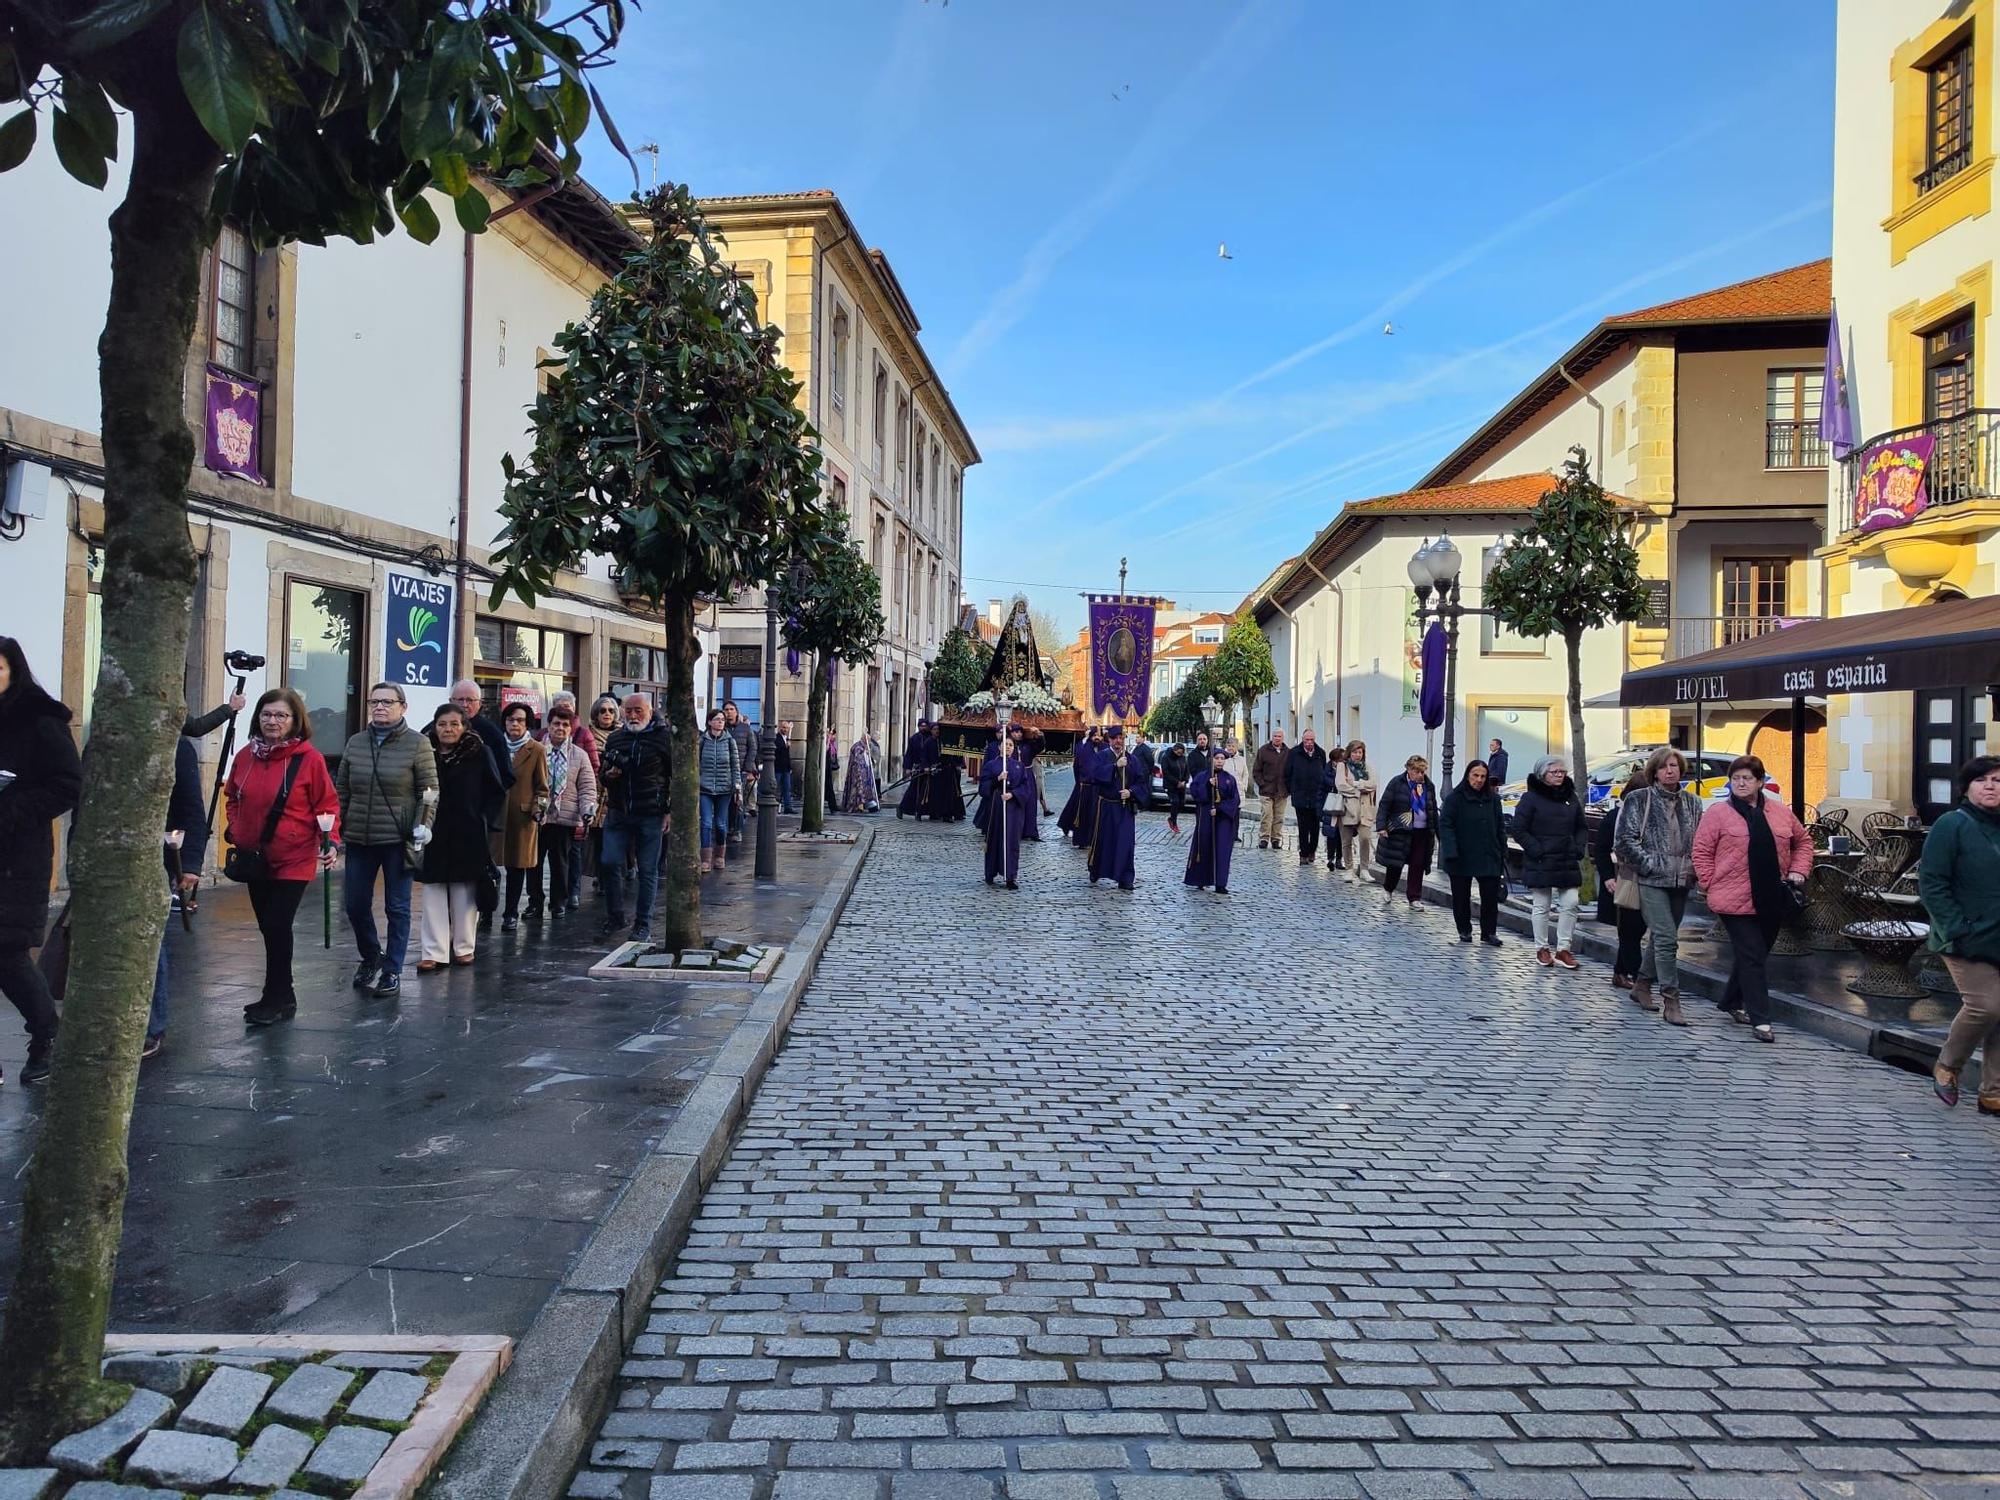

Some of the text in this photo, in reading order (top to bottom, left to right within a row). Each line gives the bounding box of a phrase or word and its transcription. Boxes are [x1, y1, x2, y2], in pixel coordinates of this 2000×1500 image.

[392, 576, 445, 605] VIAJES
[405, 662, 430, 684] S.C
[1783, 656, 1888, 691] casa españa
[1676, 676, 1728, 700] HOTEL
